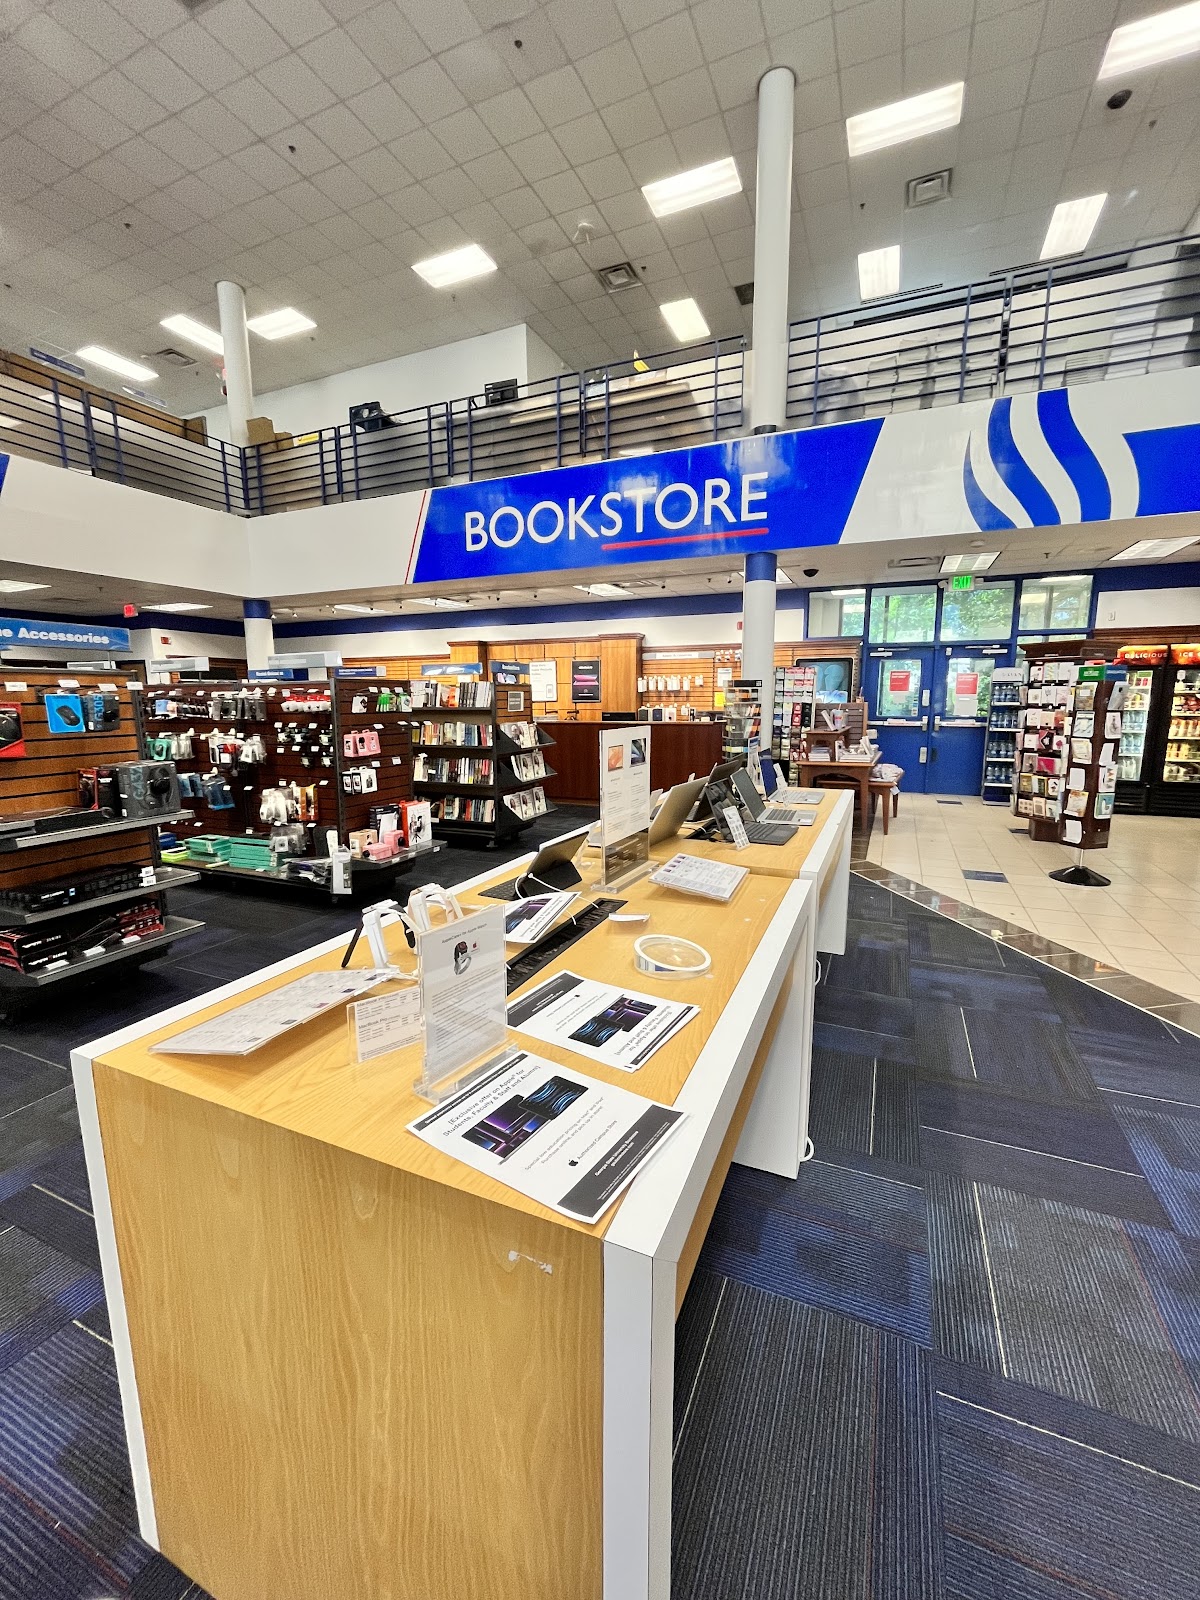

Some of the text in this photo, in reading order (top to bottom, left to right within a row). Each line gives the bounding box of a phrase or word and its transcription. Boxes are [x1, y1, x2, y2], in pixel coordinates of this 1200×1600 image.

[465, 471, 769, 552] BOOKSTORE
[952, 576, 972, 590] EXIT
[18, 628, 110, 645] Accessories
[358, 1020, 378, 1029] MacBook
[478, 1091, 492, 1104] offer
[516, 1068, 525, 1076] for
[442, 1114, 474, 1136] Students,
[471, 1098, 493, 1115] Faculty
[497, 1084, 511, 1096] Staff
[510, 1077, 521, 1087] and
[538, 1148, 548, 1157] low
[546, 1132, 566, 1150] education
[564, 1122, 577, 1135] pricing
[576, 1119, 617, 1159] Authorized Campus Store
